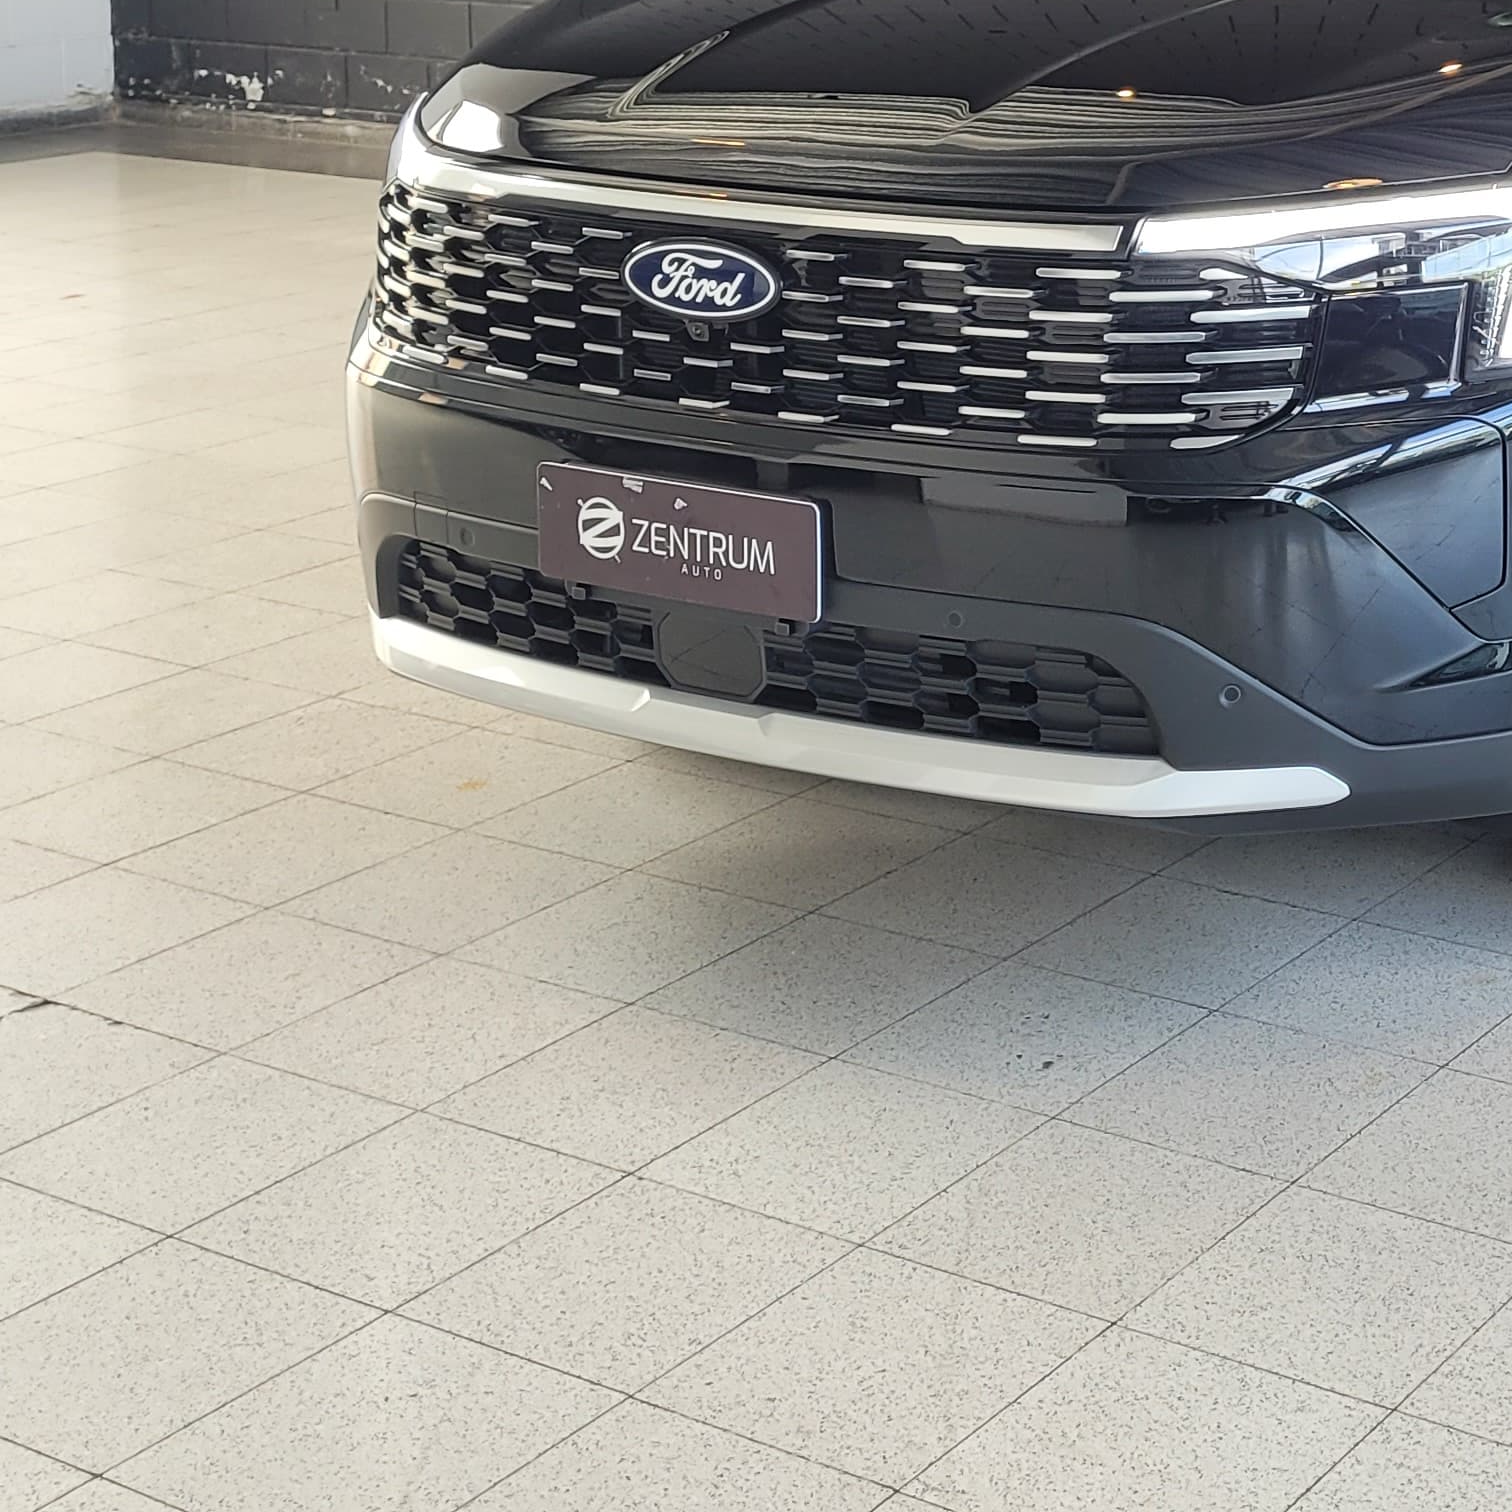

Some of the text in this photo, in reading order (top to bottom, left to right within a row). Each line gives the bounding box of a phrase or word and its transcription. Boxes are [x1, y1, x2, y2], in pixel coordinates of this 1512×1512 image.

[651, 252, 746, 307] Ford
[631, 518, 775, 575] ZENTRUM
[681, 563, 722, 580] AUTO
